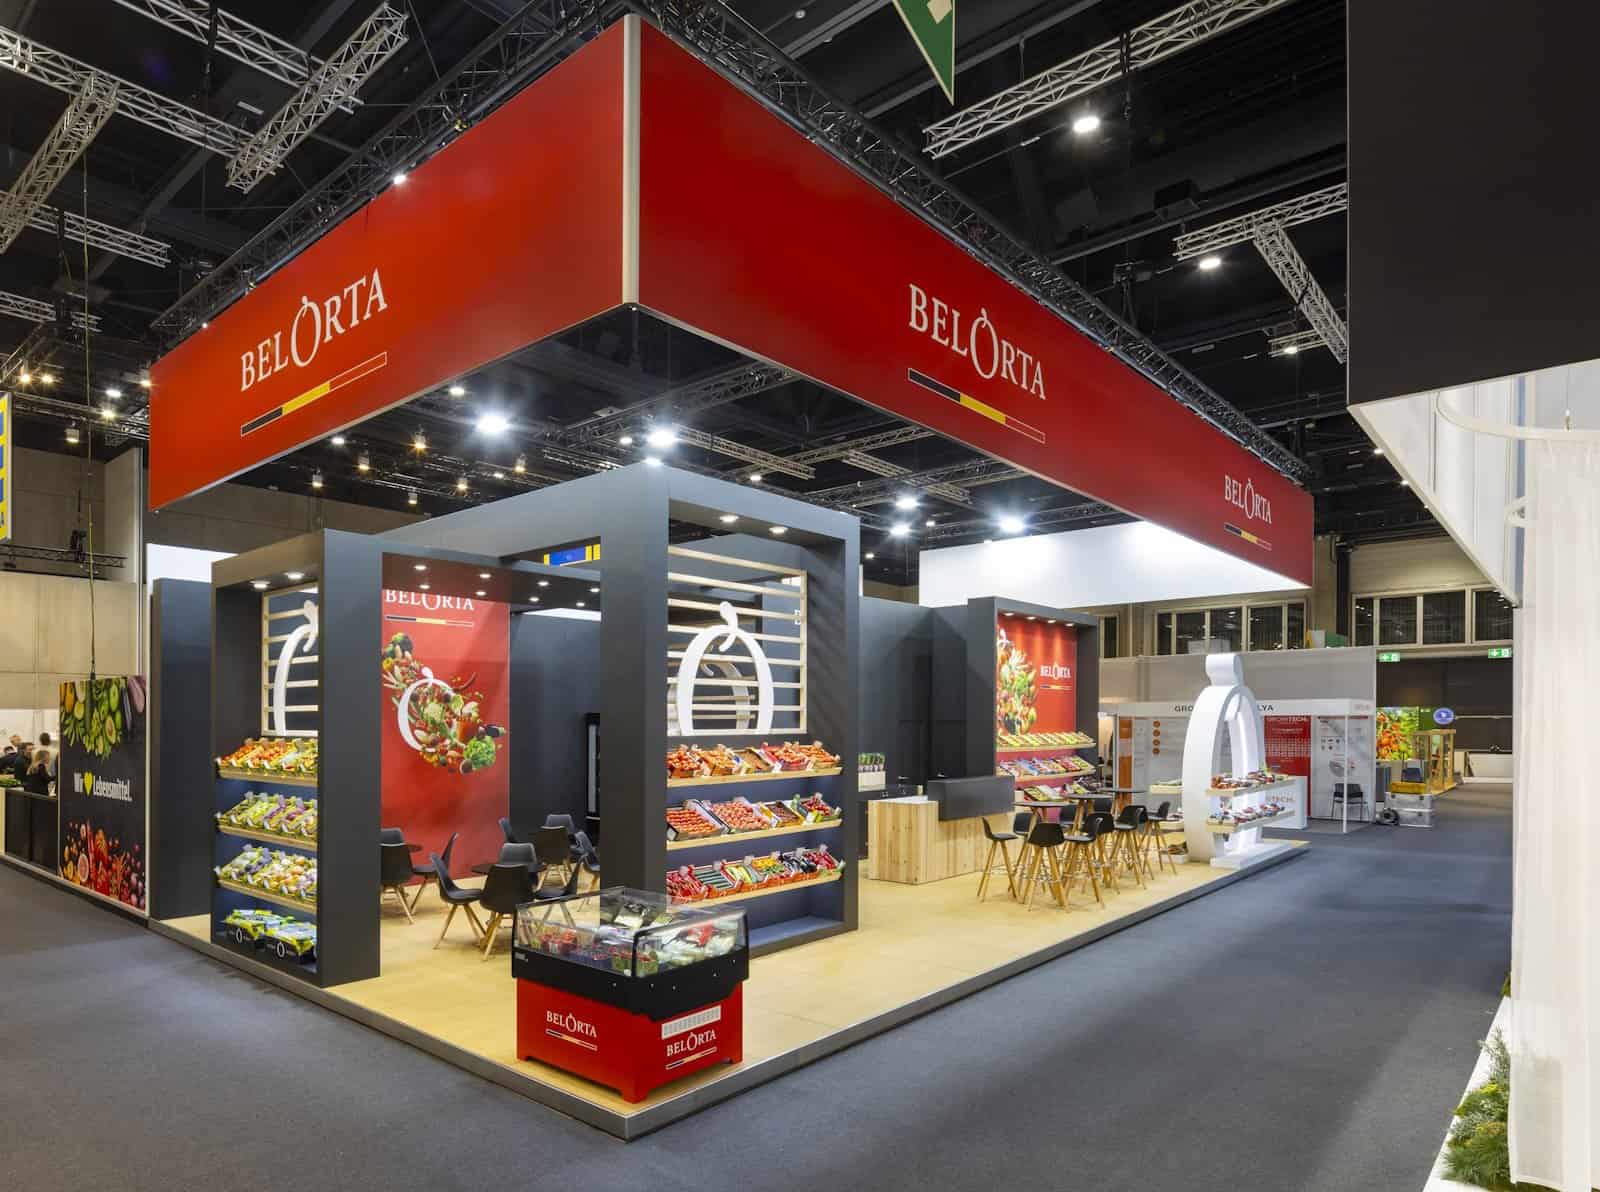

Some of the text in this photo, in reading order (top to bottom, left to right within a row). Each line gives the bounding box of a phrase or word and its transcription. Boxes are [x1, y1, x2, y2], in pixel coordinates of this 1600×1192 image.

[241, 268, 388, 392] BELORTA
[909, 283, 1046, 400] BELORTA
[546, 1010, 597, 1038] BELORTA
[667, 1029, 717, 1057] BELORTA
